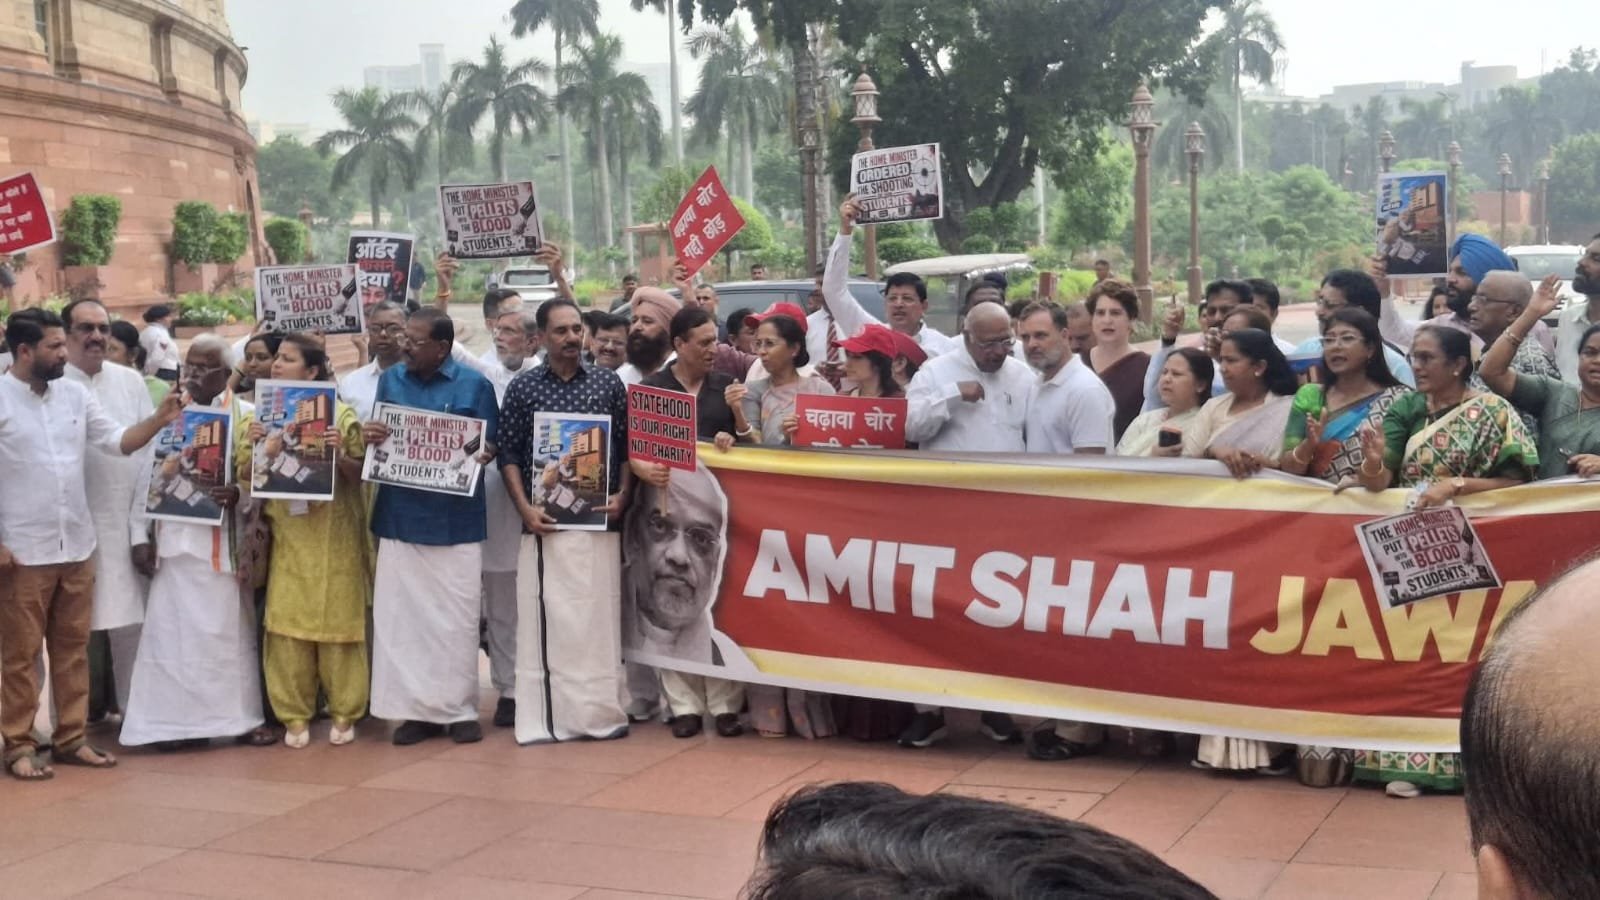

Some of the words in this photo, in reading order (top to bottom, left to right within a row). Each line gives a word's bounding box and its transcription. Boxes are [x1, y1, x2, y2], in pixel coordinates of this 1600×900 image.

[869, 154, 888, 166] HOME
[889, 149, 918, 164] MINISTER
[859, 163, 910, 183] ORDERED
[446, 191, 460, 204] THE
[461, 189, 483, 202] HOME
[483, 185, 519, 200] MINISTER
[696, 182, 718, 206] चोर
[857, 184, 869, 195] THE
[870, 176, 914, 194] SHOOTING
[451, 206, 465, 216] PUT
[470, 200, 517, 218] PELLETS
[472, 217, 511, 234] BLOOD
[682, 234, 704, 259] गद्दी
[702, 212, 726, 239] छोड़
[355, 238, 399, 259] ऑर्डर
[265, 274, 280, 285] THE
[283, 271, 305, 283] HOME
[306, 268, 342, 280] MINISTER
[271, 287, 285, 297] PUT
[291, 281, 340, 299] PELLETS
[292, 297, 333, 313] BLOOD
[631, 391, 691, 419] STATEHOOD
[385, 413, 401, 426] THE
[404, 415, 427, 428] HOME
[430, 417, 468, 432] MINISTER
[630, 416, 638, 430] IS
[641, 419, 660, 435] OUR
[805, 408, 856, 431] चढ़ावा
[864, 406, 896, 431] चोर
[410, 430, 462, 449] PELLETS
[407, 447, 452, 463] BLOOD
[631, 439, 648, 453] NOT
[651, 442, 692, 464] CHARITY
[1370, 525, 1393, 543] THE
[1393, 516, 1422, 535] HOME
[1421, 510, 1455, 527] MINISTER
[1383, 540, 1404, 555] PUT
[1408, 525, 1459, 552] PELLETS
[1401, 559, 1416, 570] THE
[1414, 544, 1461, 568] BLOOD
[743, 528, 956, 619] AMIT
[964, 551, 1234, 650] SHAH
